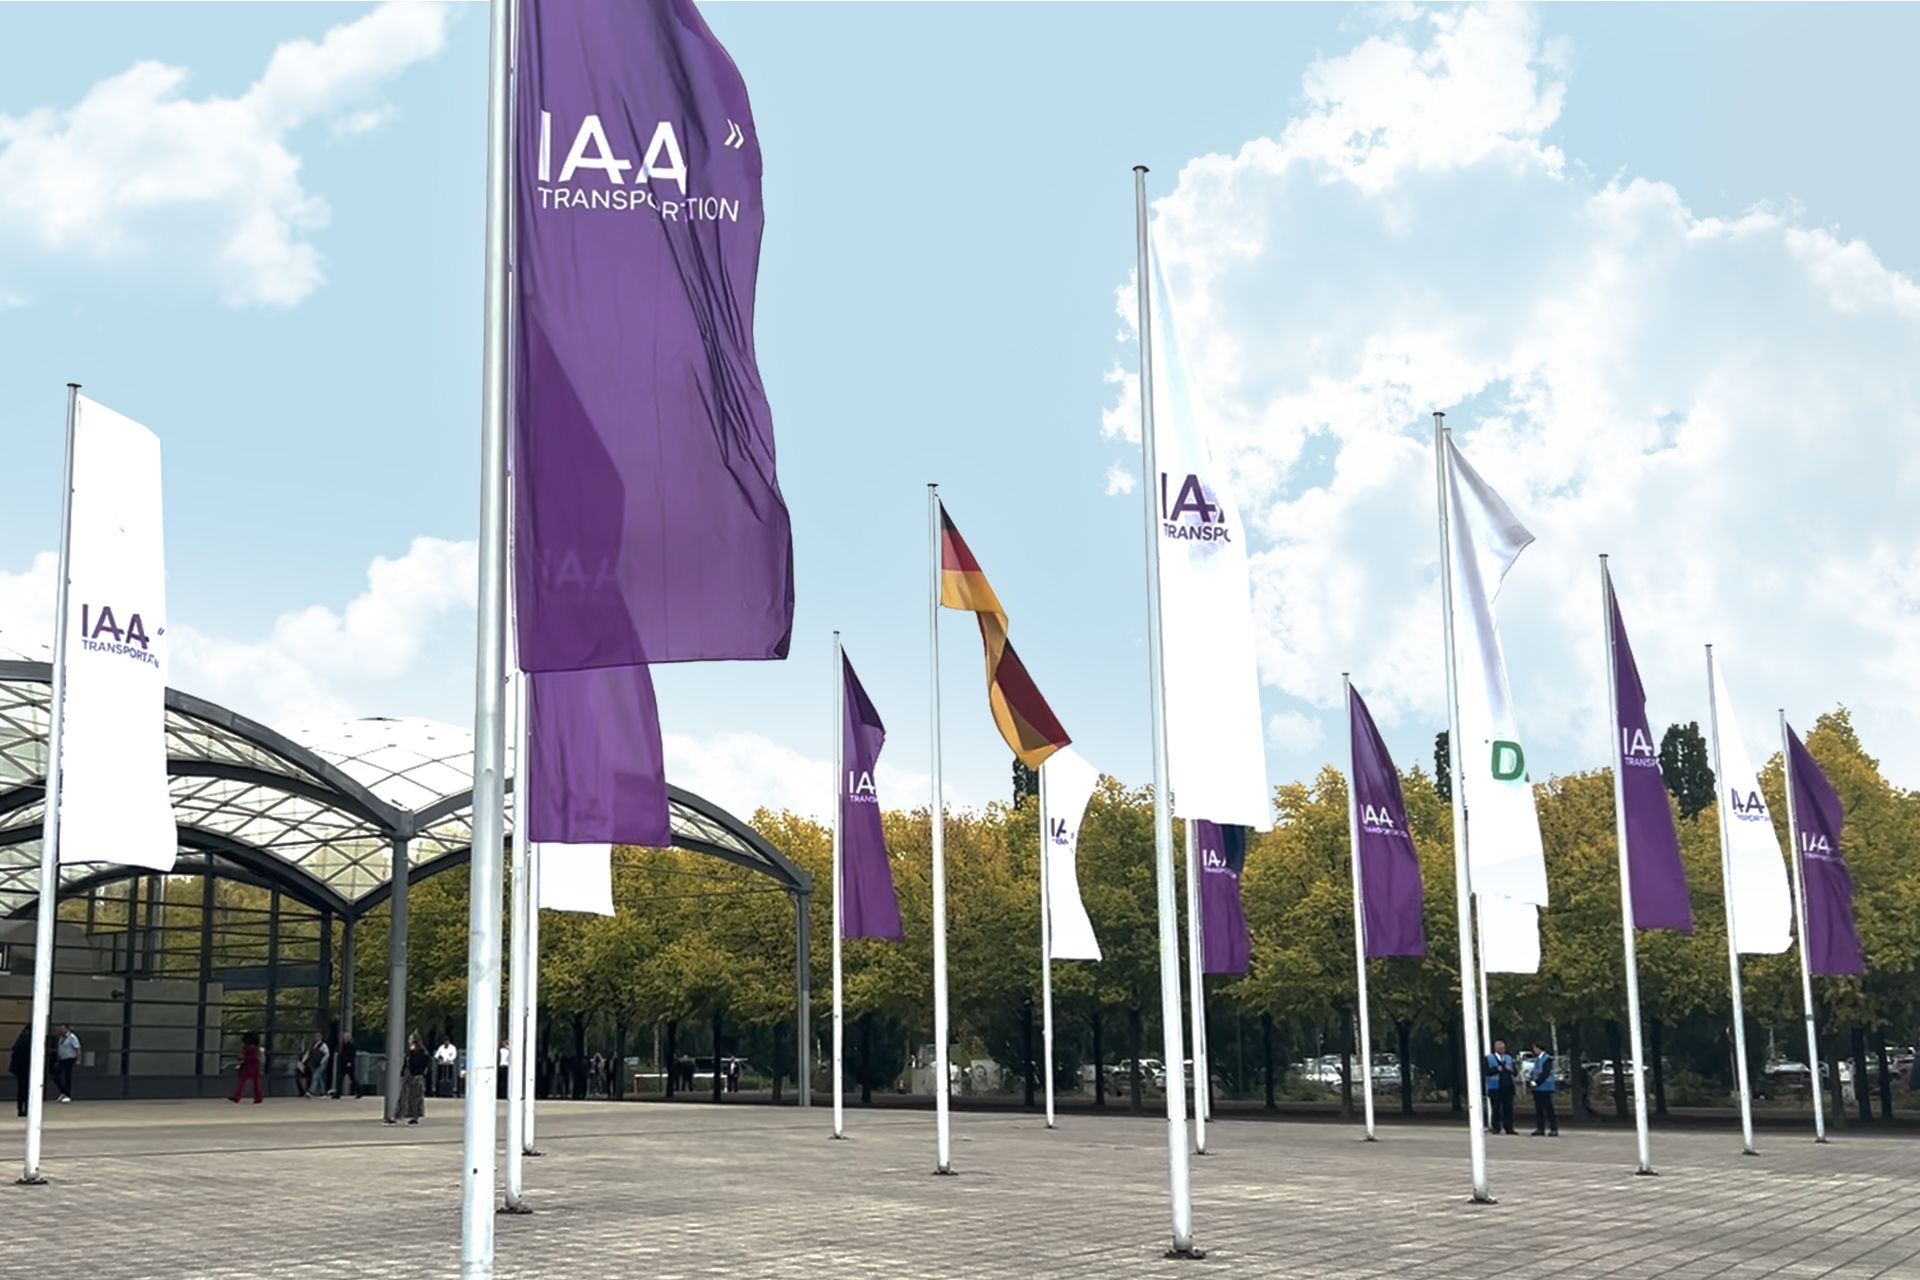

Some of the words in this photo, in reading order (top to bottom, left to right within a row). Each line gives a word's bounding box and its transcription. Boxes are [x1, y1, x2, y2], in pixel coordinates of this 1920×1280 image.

[538, 110, 689, 196] IAA
[1161, 472, 1225, 524] IA
[82, 603, 150, 650] IAA
[849, 770, 876, 795] IA
[1360, 804, 1394, 828] IAA
